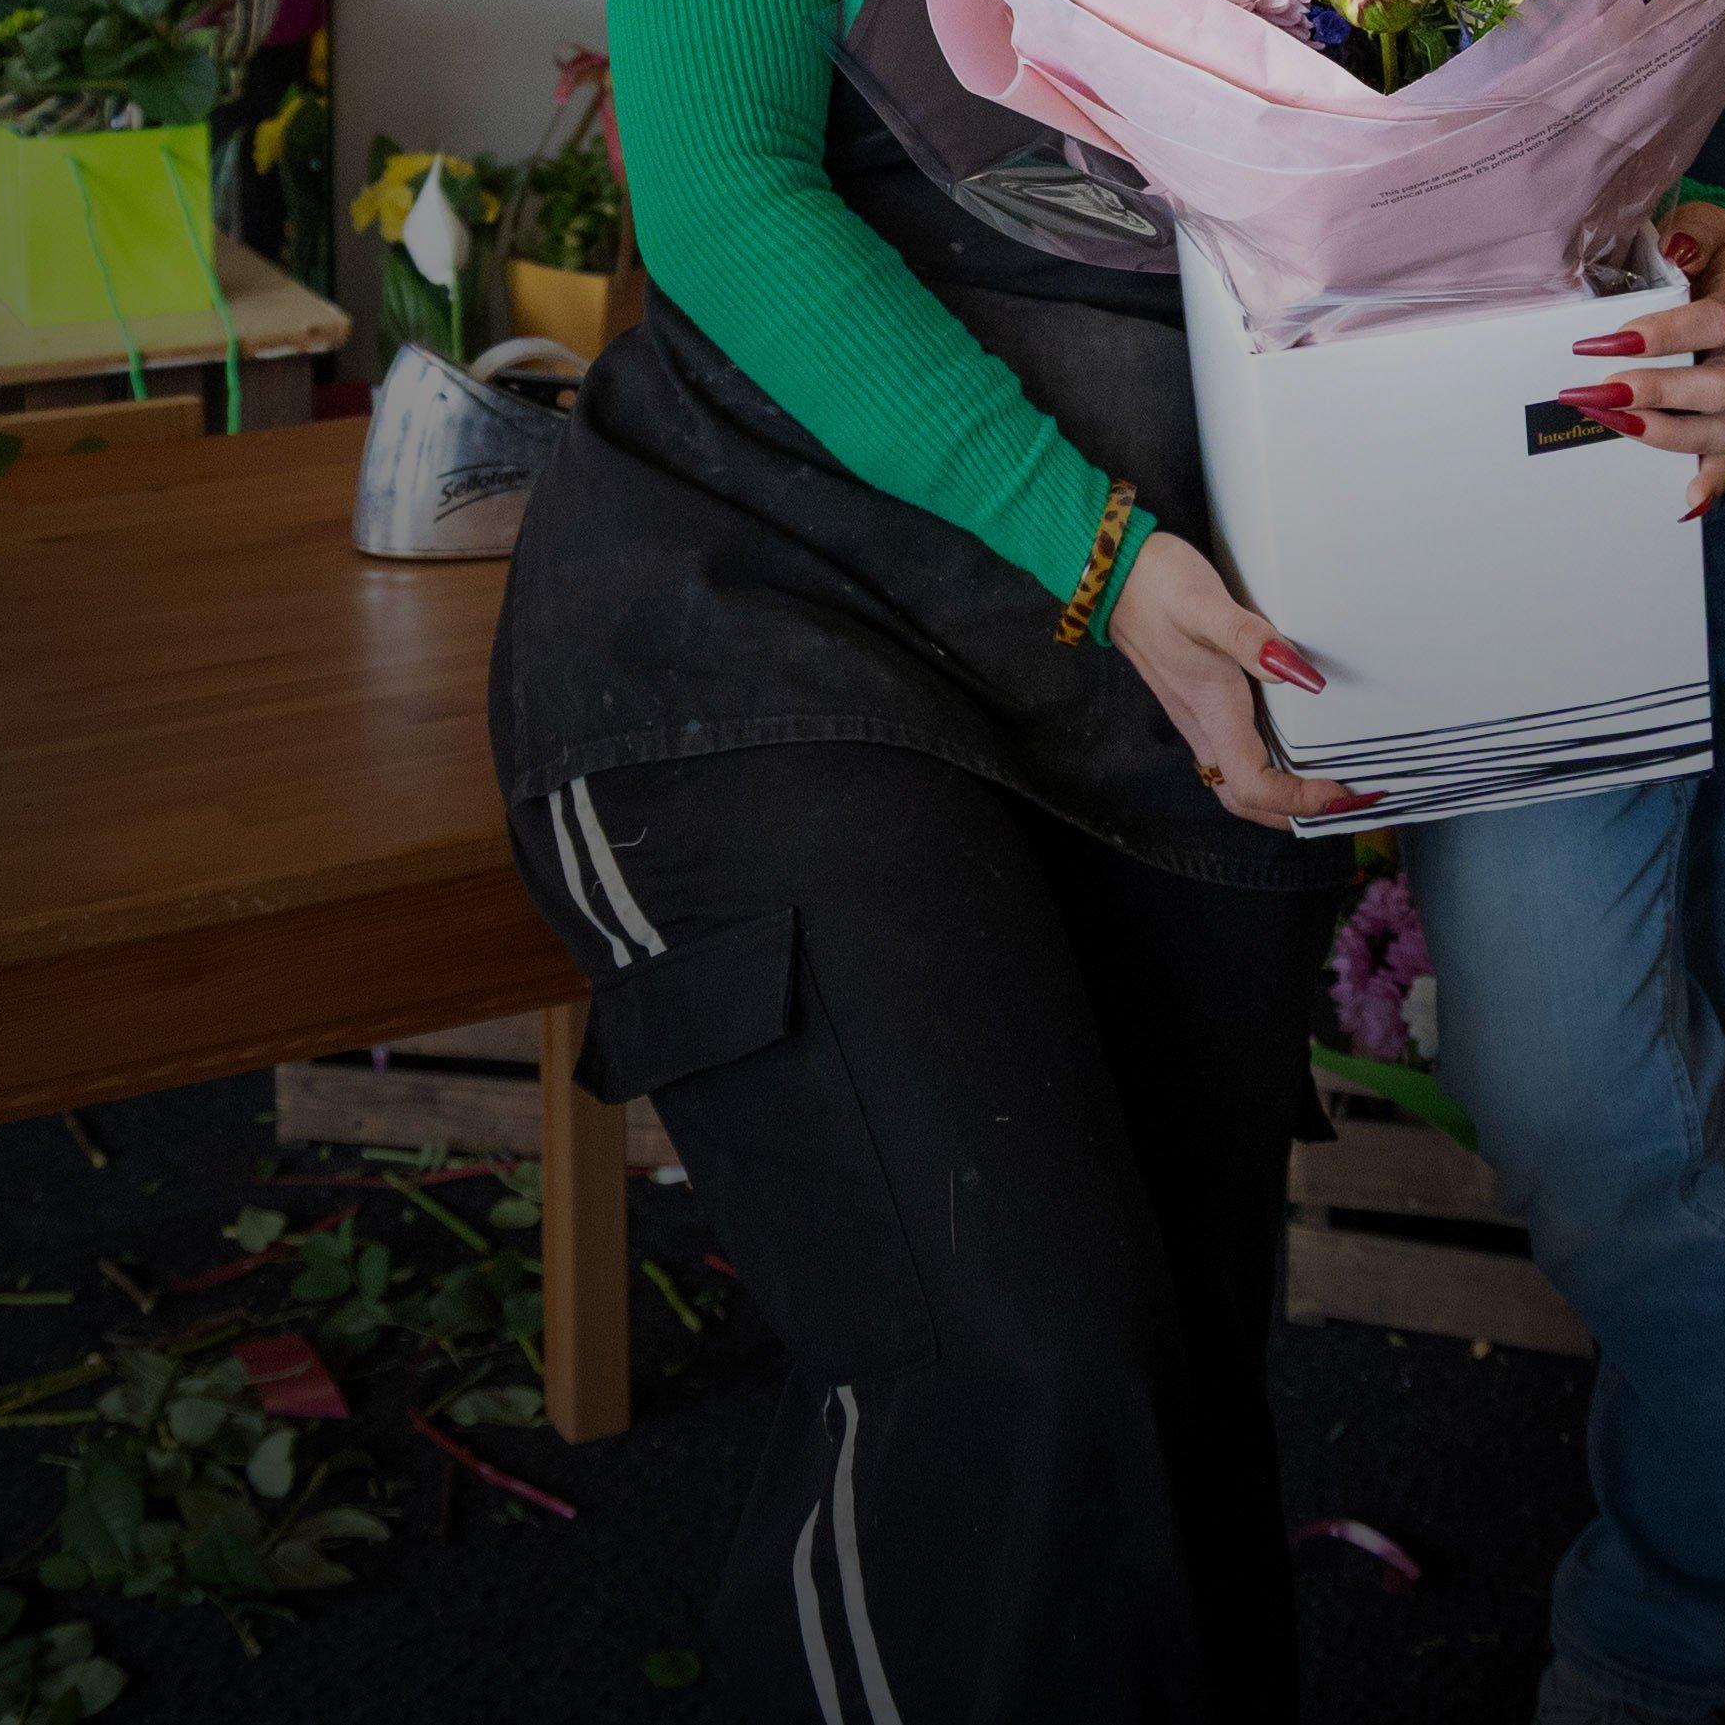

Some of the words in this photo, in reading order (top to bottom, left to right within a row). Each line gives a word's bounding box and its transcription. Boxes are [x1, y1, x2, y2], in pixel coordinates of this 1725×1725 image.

[1370, 198, 1389, 209] and
[1390, 189, 1423, 205] ethical
[1424, 171, 1475, 193] standards.
[1490, 149, 1525, 170] printed
[1525, 139, 1545, 153] with
[1619, 78, 1642, 95] Once
[1668, 46, 1691, 64] done
[1379, 188, 1399, 199] This
[1401, 179, 1429, 195] paper
[1441, 164, 1469, 179] made
[1470, 153, 1496, 169] using
[1498, 140, 1524, 157] wood
[1524, 130, 1546, 143] from
[1571, 92, 1605, 118] certified
[1606, 72, 1636, 95] forests
[1635, 59, 1654, 76] that
[1654, 51, 1668, 64] are
[1669, 24, 1707, 55] managed
[1537, 424, 1606, 446] Interflora
[438, 467, 531, 507] Sellotape
